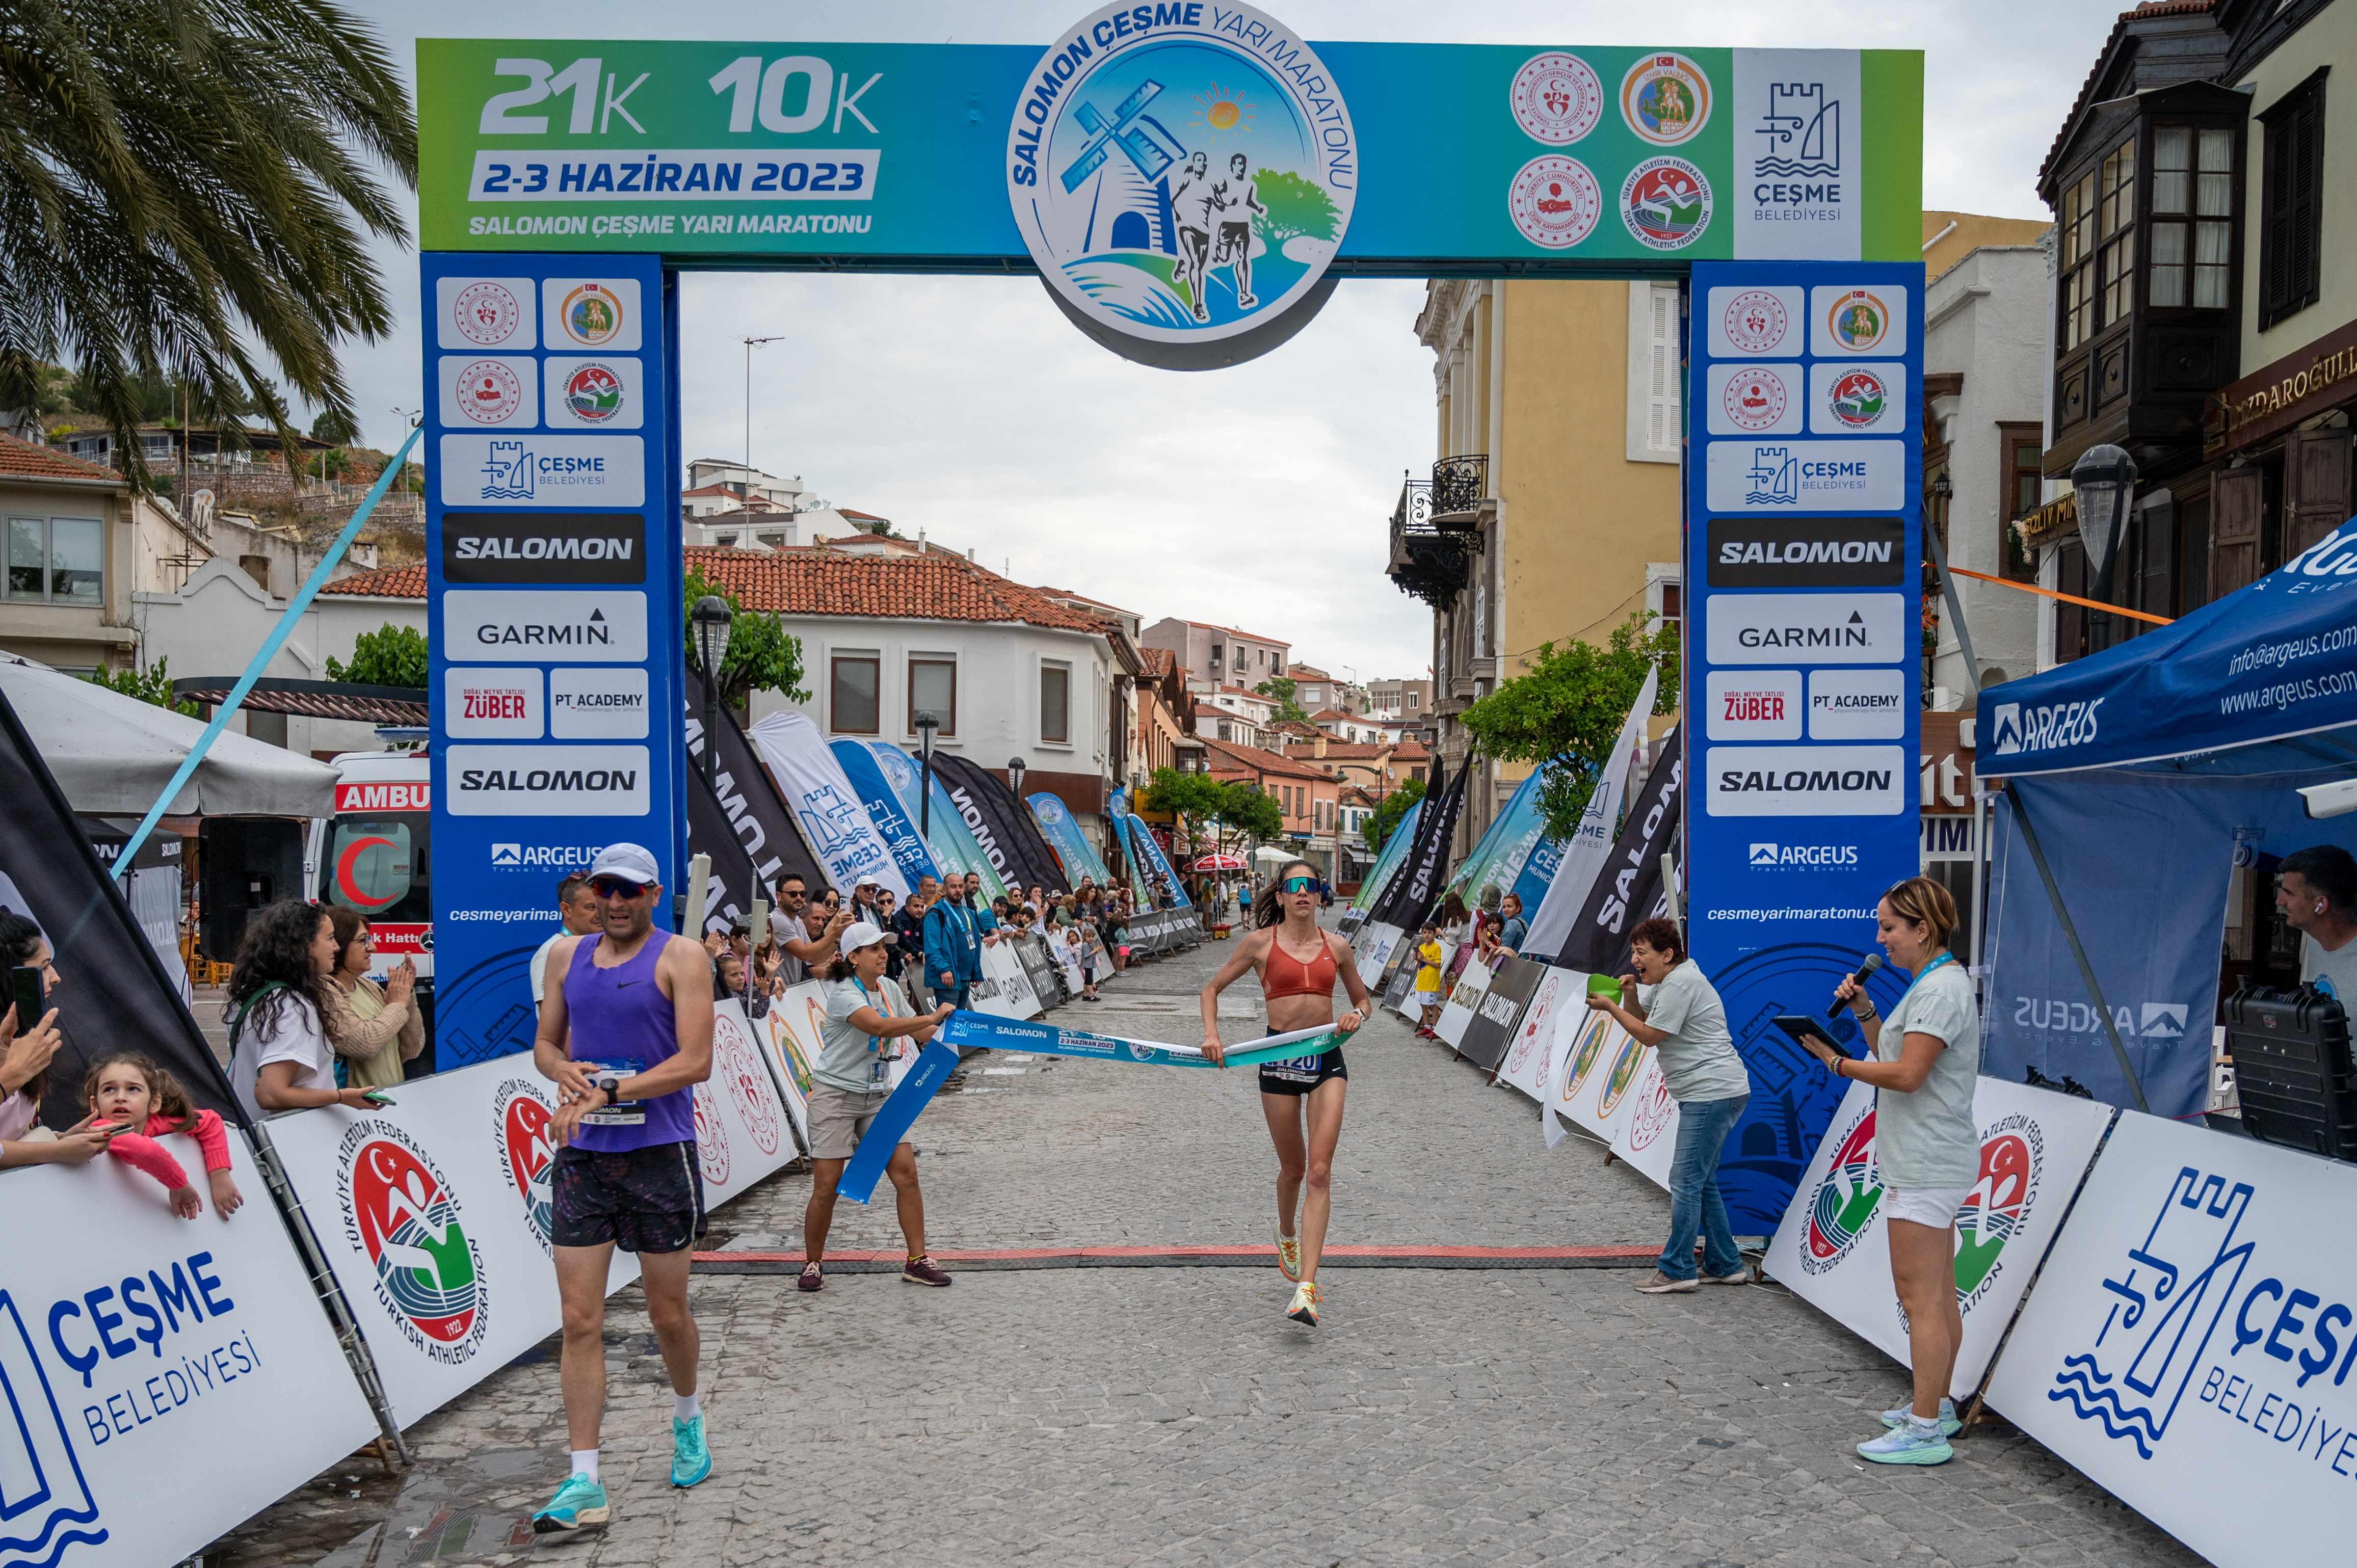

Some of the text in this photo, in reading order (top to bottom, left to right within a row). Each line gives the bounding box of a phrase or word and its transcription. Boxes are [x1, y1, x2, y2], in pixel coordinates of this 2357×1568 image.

[1643, 69, 1691, 83] İZMİR VALİLİĞİ
[479, 56, 884, 134] 21K 10K
[1013, 2, 1353, 190] SALOMON ÇEŞME YARI MARATONU
[483, 154, 863, 193] 2-3 HAZİRAN 2023
[1623, 158, 1710, 201] TÜRKİYE ATLETİZM FEDERASYONU
[1527, 175, 1546, 199] TÜRKİYE
[1754, 184, 1841, 207] ÇEŞME
[1755, 207, 1841, 222] BELEDİYESİ
[469, 215, 872, 239] SALOMON ÇEŞME YARI MARATONU
[1624, 209, 1709, 249] TURKISH ATHLETIC FEDERATION
[539, 458, 604, 473] ÇEŞME
[1802, 463, 1866, 479] ÇEŞME
[539, 475, 605, 485] BELEDİYESİ
[1803, 480, 1866, 489] BELEDİYESİ
[456, 538, 633, 560] SALOMON
[1719, 542, 1892, 564] SALOMON
[478, 624, 608, 645] GARMIN
[1739, 627, 1865, 647] GARMIN
[2229, 626, 2357, 676] info@argeus.com
[2221, 671, 2357, 714] www.argeus.com
[464, 695, 526, 719] ZÜBER
[1725, 698, 1784, 721] ZÜBER
[2022, 697, 2105, 752] ARGEUS
[460, 770, 636, 791] SALOMON
[1719, 770, 1891, 791] SALOMON
[1572, 837, 1602, 849] DİYESİ
[1596, 760, 1681, 934] SALOM
[1534, 849, 1562, 875] CES
[1780, 846, 1858, 865] ARGEUS
[1528, 864, 1555, 885] MUNICI
[1708, 907, 1877, 922] cesmeyarimaratonu.c
[386, 933, 418, 943] Hattı
[970, 976, 1002, 1002] SALOMON
[1003, 973, 1034, 1005] GARMIN
[1451, 982, 1483, 1012] SALOMON
[1479, 991, 1519, 1028] SALOMON
[996, 1026, 1047, 1039] SALOMON
[1071, 1039, 1096, 1047] HAZİRAN
[920, 1063, 936, 1081] ARGEUS
[1277, 1067, 1306, 1075] SALOMON
[493, 1078, 557, 1188] TÜRKİYE ATLETİZM FEDERA
[1829, 1106, 1867, 1159] TÜRKİYE
[1980, 1112, 2044, 1235] ATLETİZM FEDERASYONU
[335, 1119, 462, 1253] TÜRKİYE ATLETİZM FEDERASYONU
[1798, 1181, 1879, 1275] TURKISH ATHLETIC FEDERATION
[1815, 1241, 1827, 1255] 1922
[373, 1238, 489, 1365] TURKISH ATHLETIC FEDERATION
[48, 1251, 235, 1389] ÇEŞME
[444, 1319, 464, 1338] 1922
[83, 1329, 261, 1446] BELEDİYESİ
[2200, 1366, 2357, 1479] BELEDİYE
